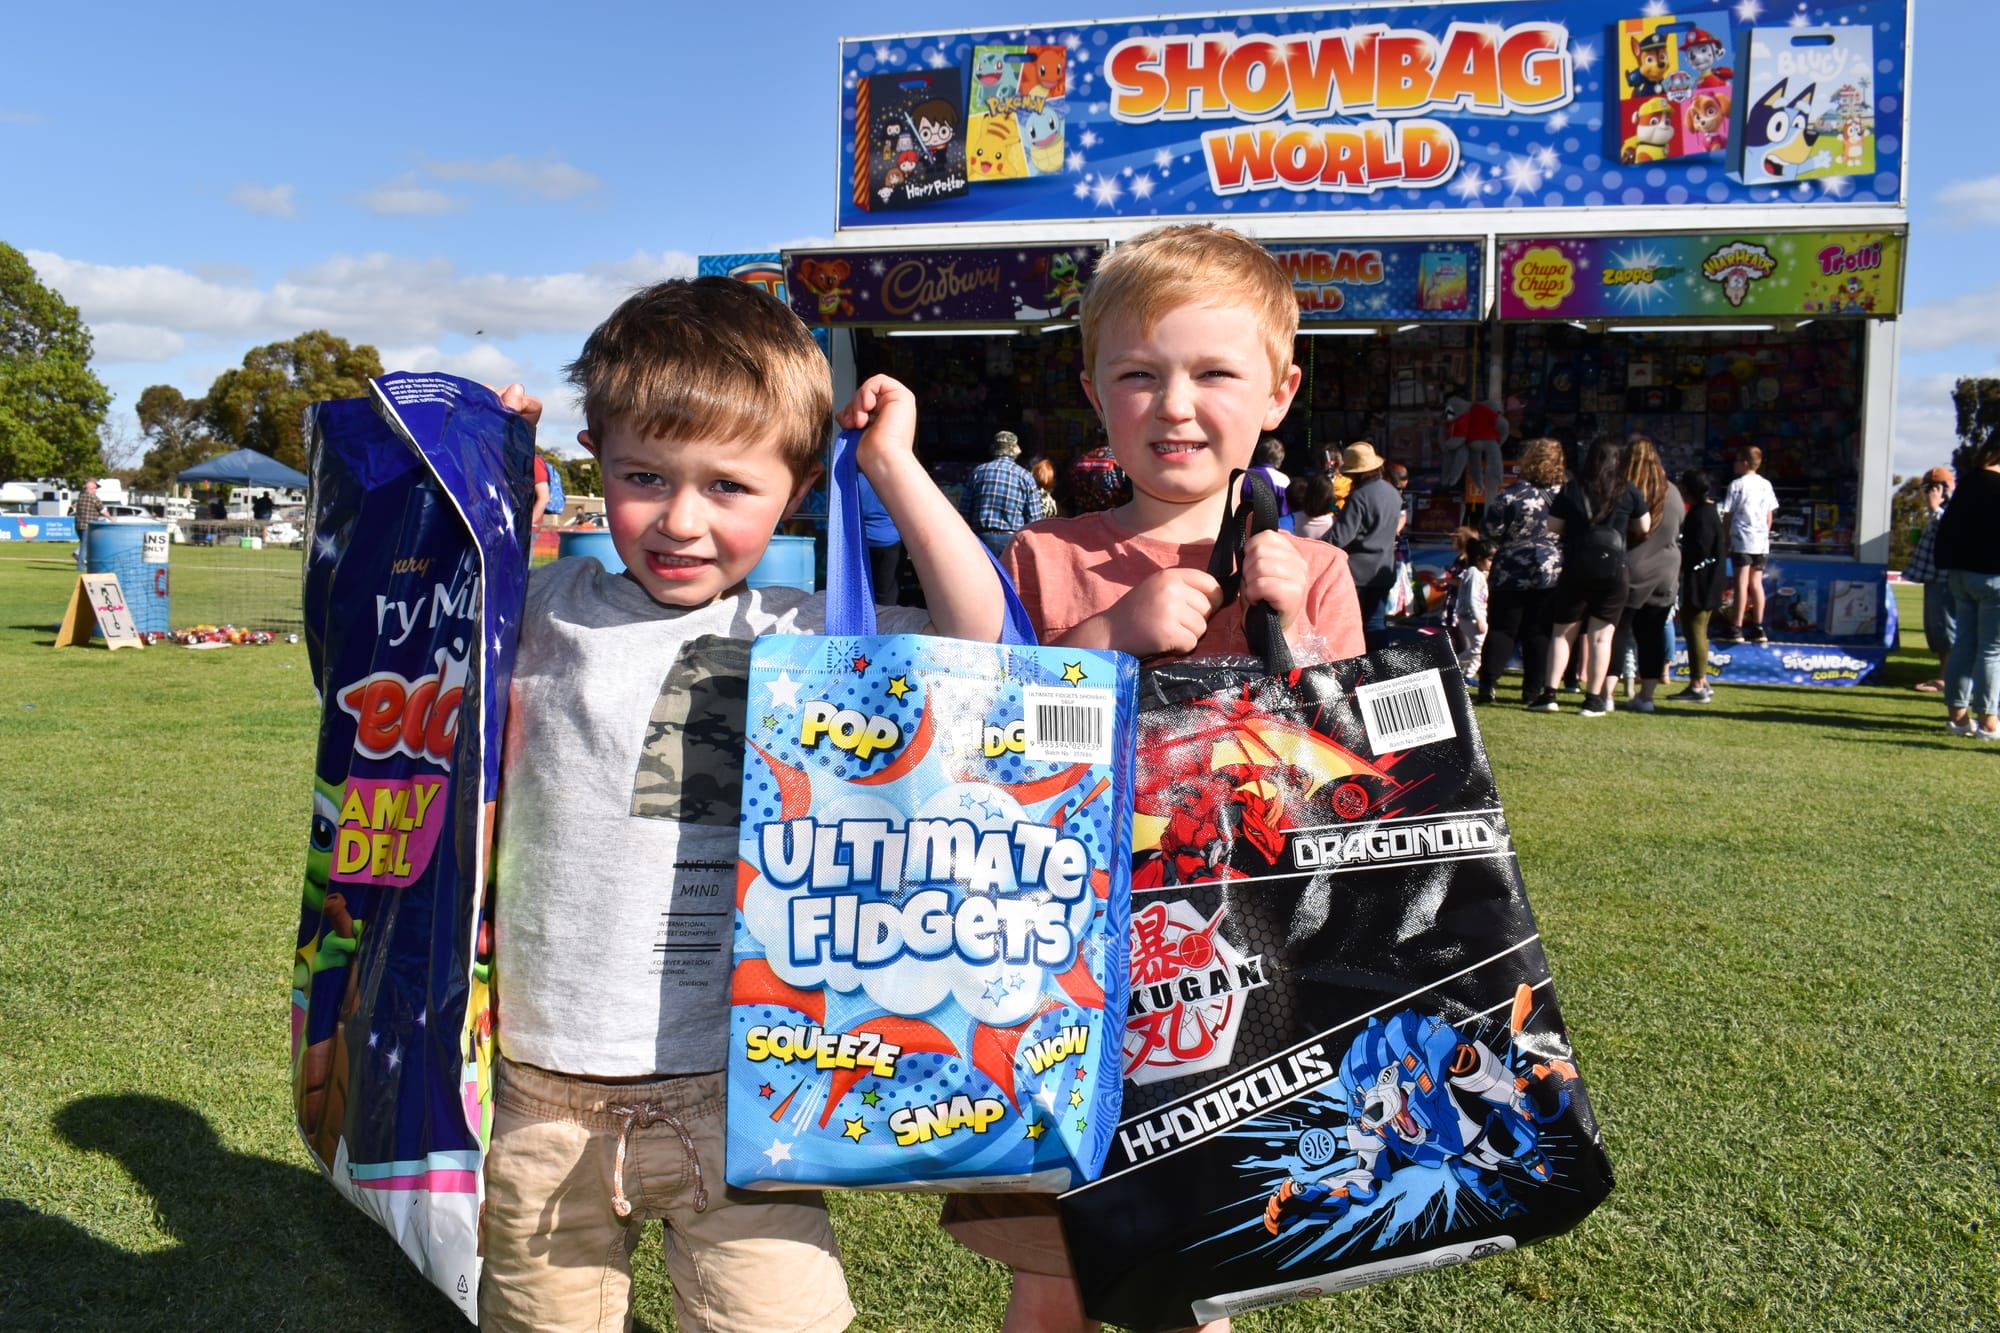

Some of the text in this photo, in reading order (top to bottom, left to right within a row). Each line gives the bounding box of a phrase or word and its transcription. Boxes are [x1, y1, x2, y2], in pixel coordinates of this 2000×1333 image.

[1108, 26, 1569, 119] SHOWBAG
[1204, 123, 1457, 190] WORLD
[905, 174, 966, 200] Harry Potter
[1521, 262, 1568, 278] Chupa
[1702, 248, 1777, 277] WARHEADS
[1817, 240, 1882, 275] Trolli
[881, 260, 1001, 315] Cadbury
[1518, 277, 1566, 299] Chups
[800, 700, 901, 761] POP
[762, 818, 1089, 899] ULTIMATE
[1294, 819, 1495, 869] DRAGONOID
[680, 884, 720, 897] MIND
[789, 890, 1073, 966] FIDGETS
[746, 1025, 901, 1079] SQUEEZE
[888, 1094, 1006, 1147] SNAP
